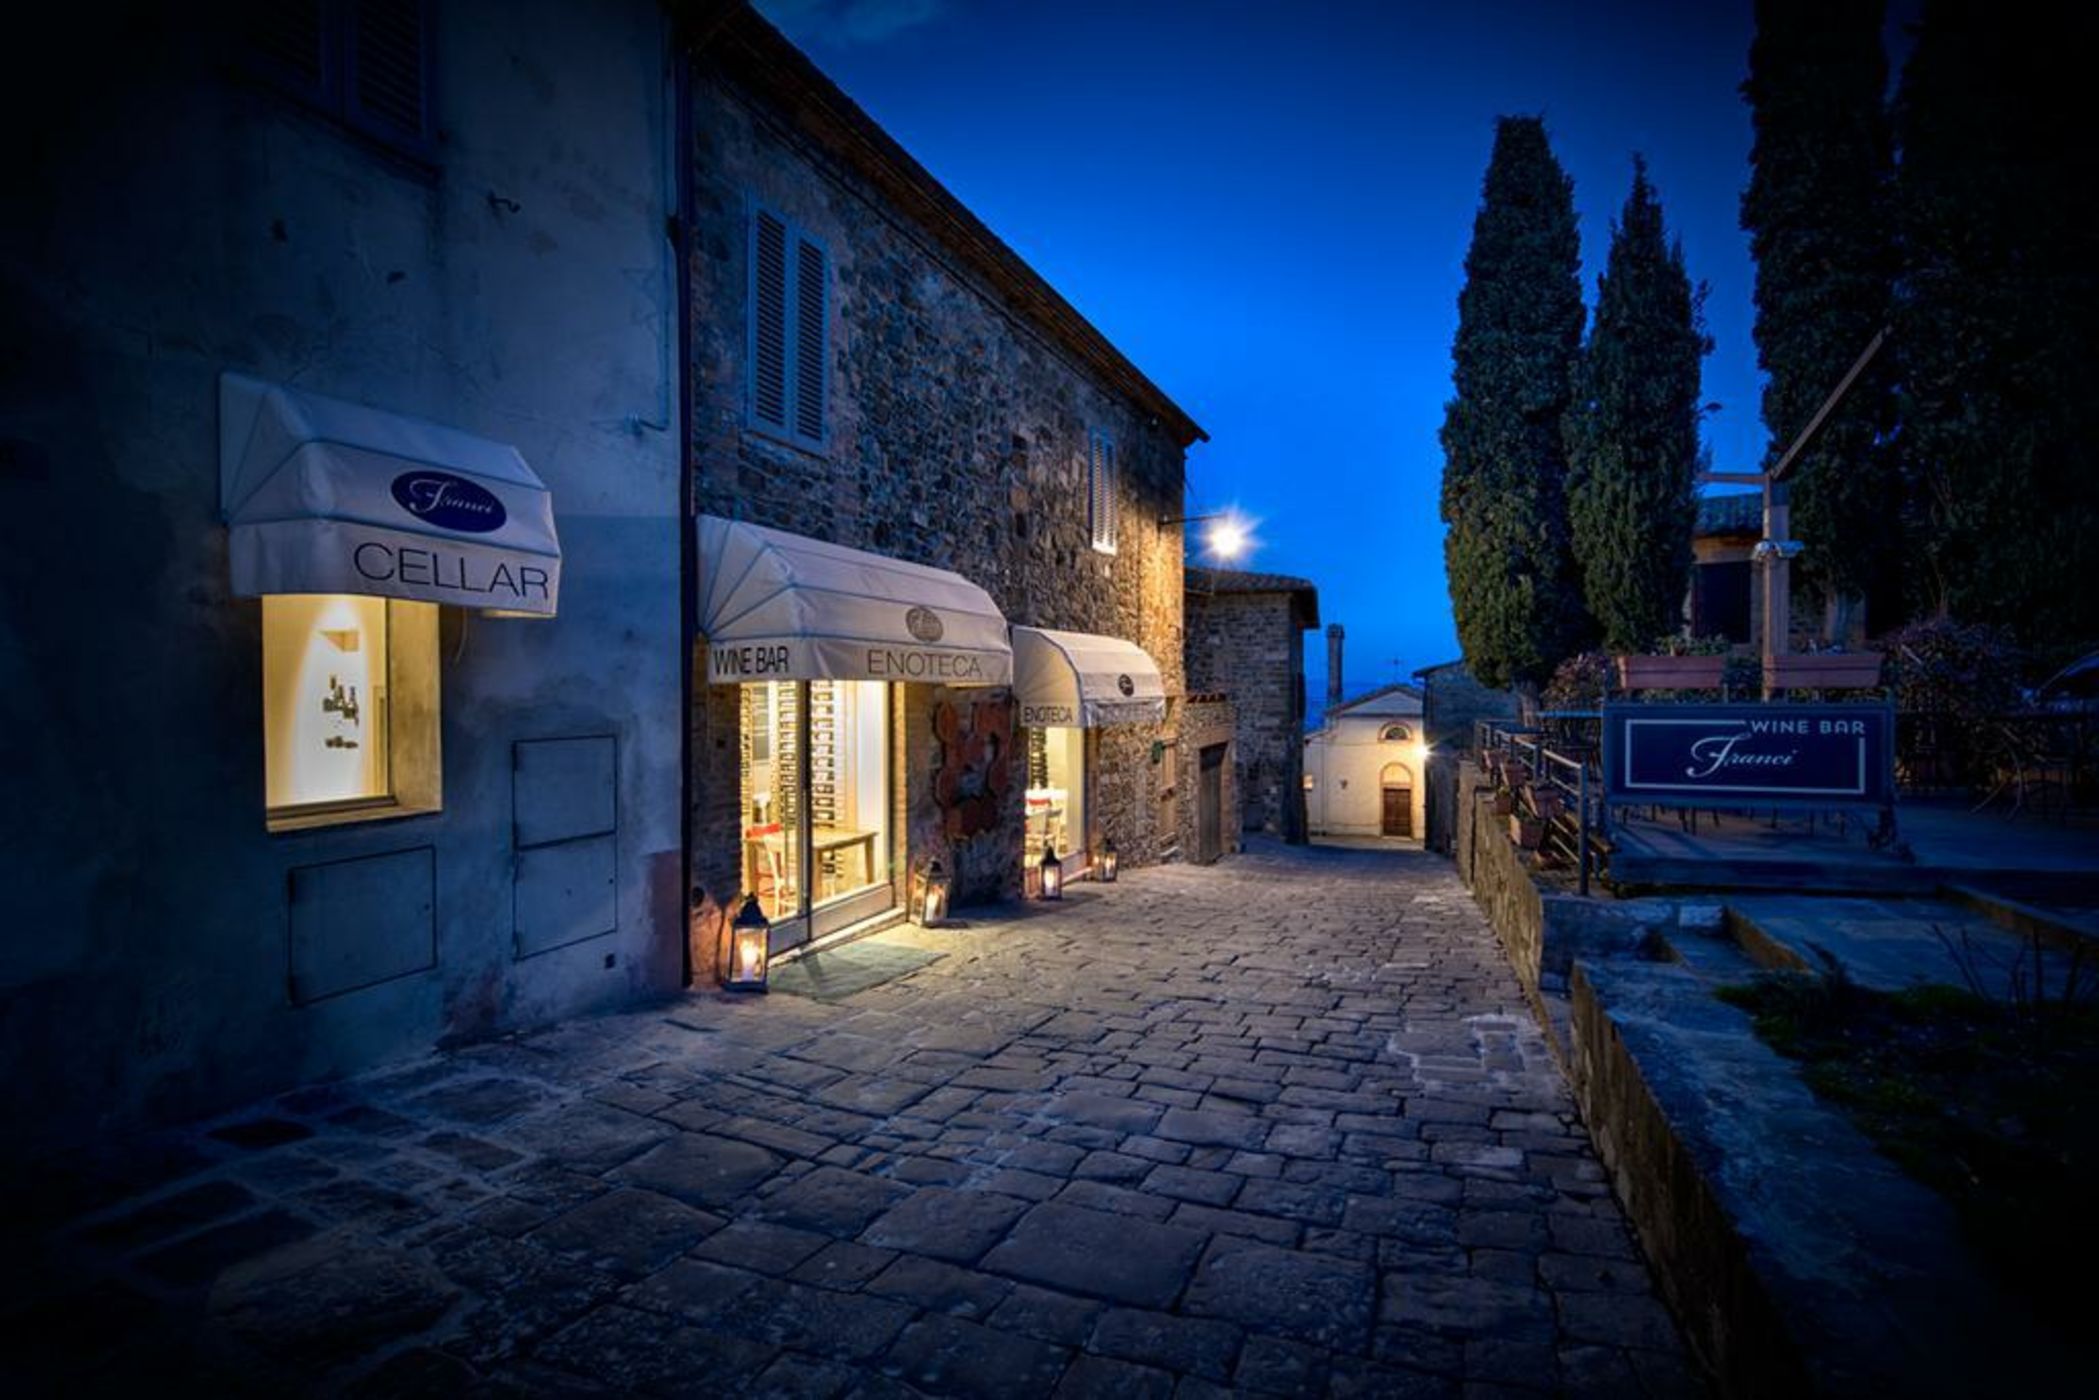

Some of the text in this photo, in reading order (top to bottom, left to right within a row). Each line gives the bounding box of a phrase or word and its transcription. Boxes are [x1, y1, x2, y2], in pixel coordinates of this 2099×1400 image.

[354, 542, 549, 600] CELLAR
[714, 646, 790, 674] WINE BAR
[867, 649, 983, 677] ENOTECA
[1023, 706, 1073, 723] ENOTECA
[1751, 720, 1866, 735] WINE BAR
[1685, 732, 1798, 778] Franci
